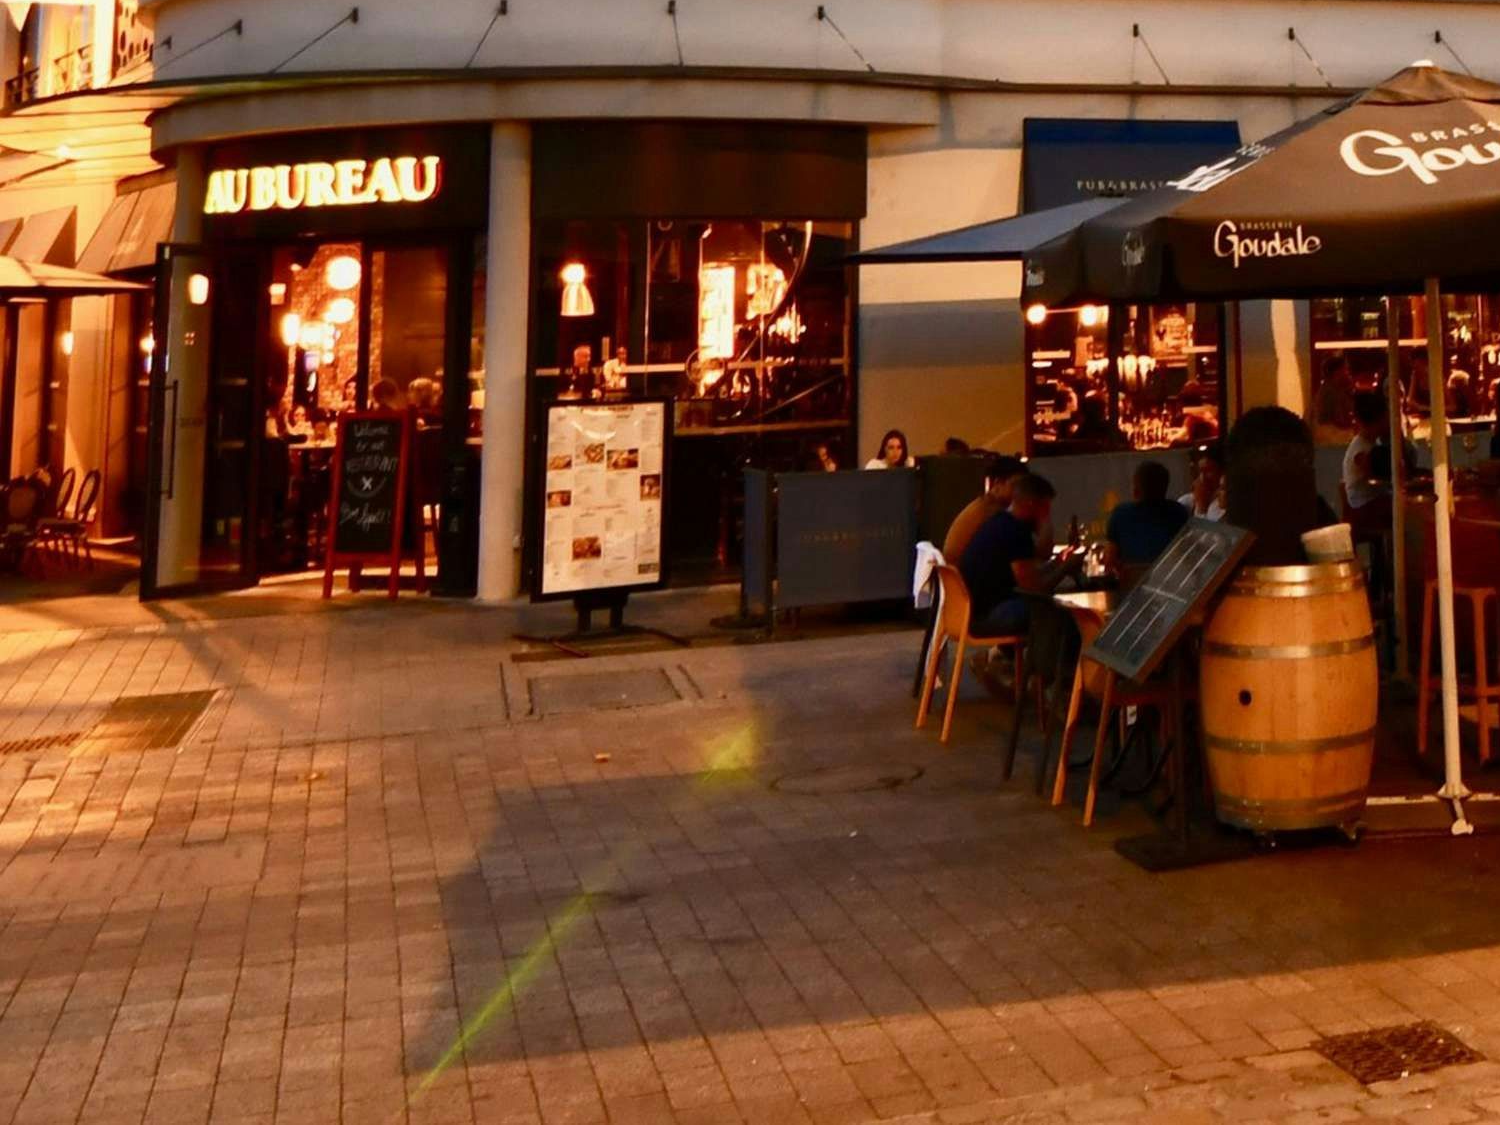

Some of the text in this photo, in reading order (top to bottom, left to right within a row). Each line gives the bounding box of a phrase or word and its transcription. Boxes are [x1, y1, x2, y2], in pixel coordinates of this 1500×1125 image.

[203, 156, 440, 214] AU BUREAU
[1214, 220, 1321, 268] Goudale
